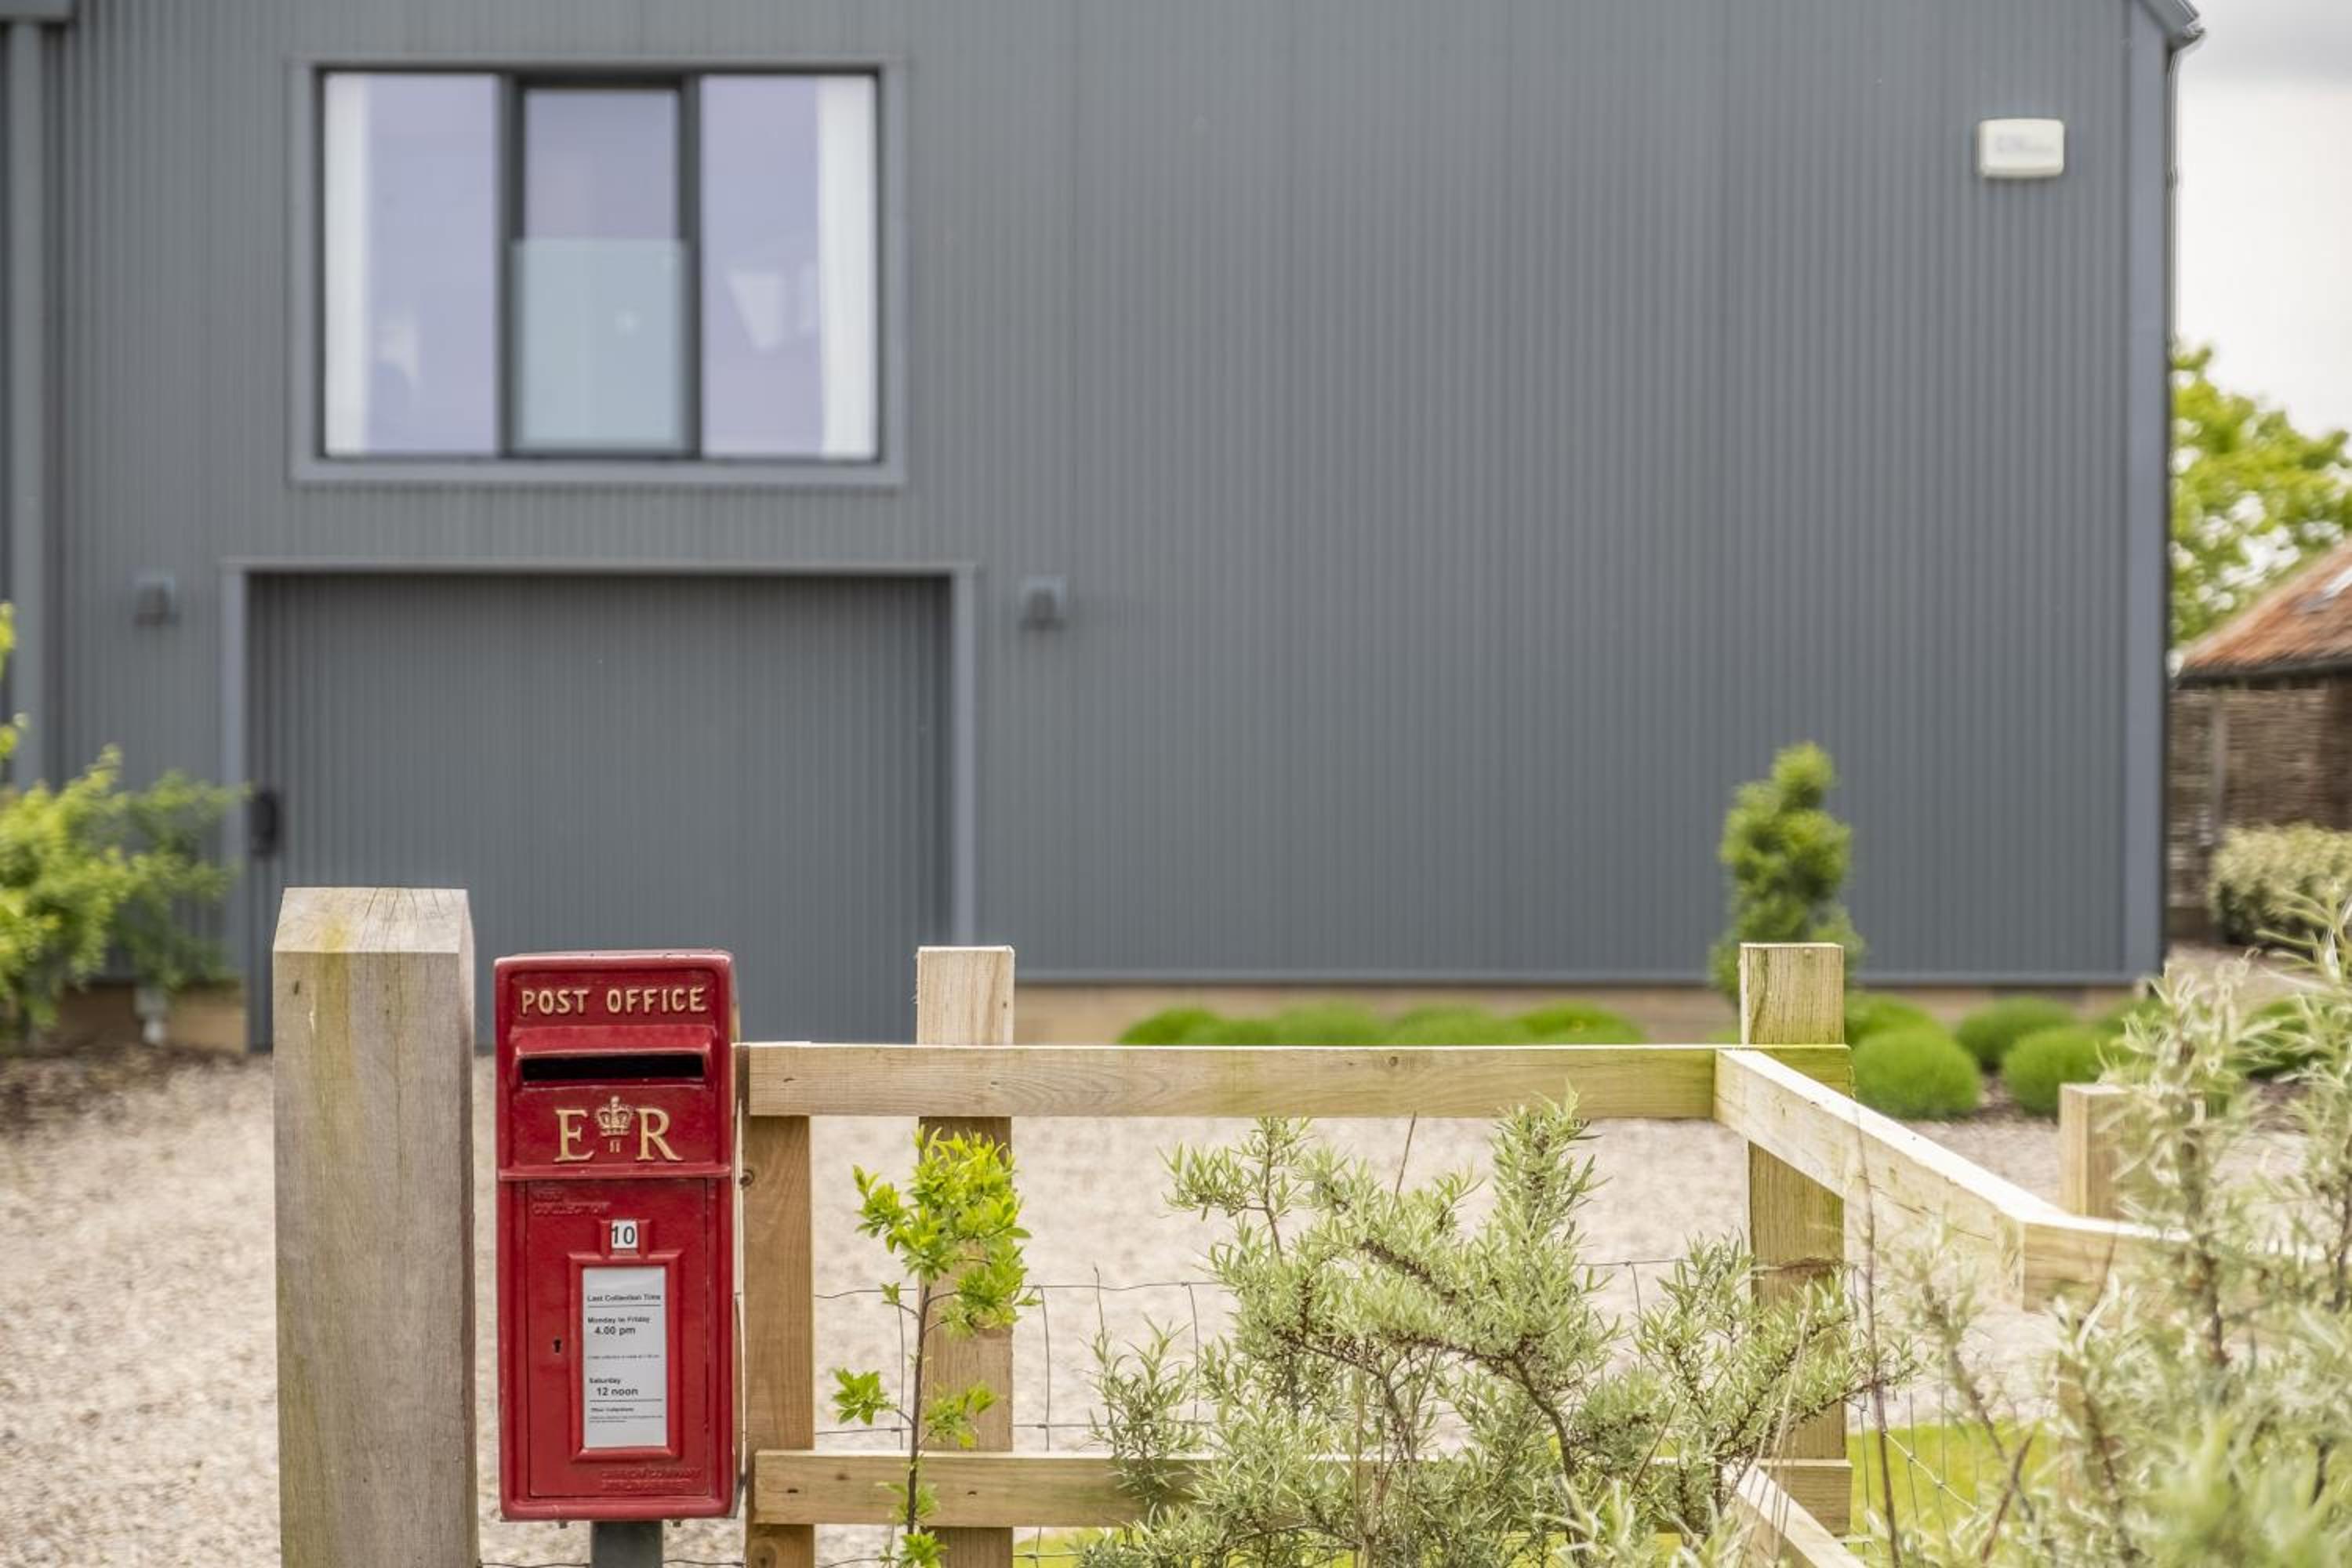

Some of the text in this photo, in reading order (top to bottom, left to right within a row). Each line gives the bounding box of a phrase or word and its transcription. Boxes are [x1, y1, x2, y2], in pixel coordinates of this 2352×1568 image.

[521, 986, 707, 1014] POST OFFICE
[554, 1107, 684, 1162] E R
[612, 1225, 636, 1245] 10
[594, 1326, 636, 1336] 4.00 pm
[597, 1387, 638, 1396] 12 noon
